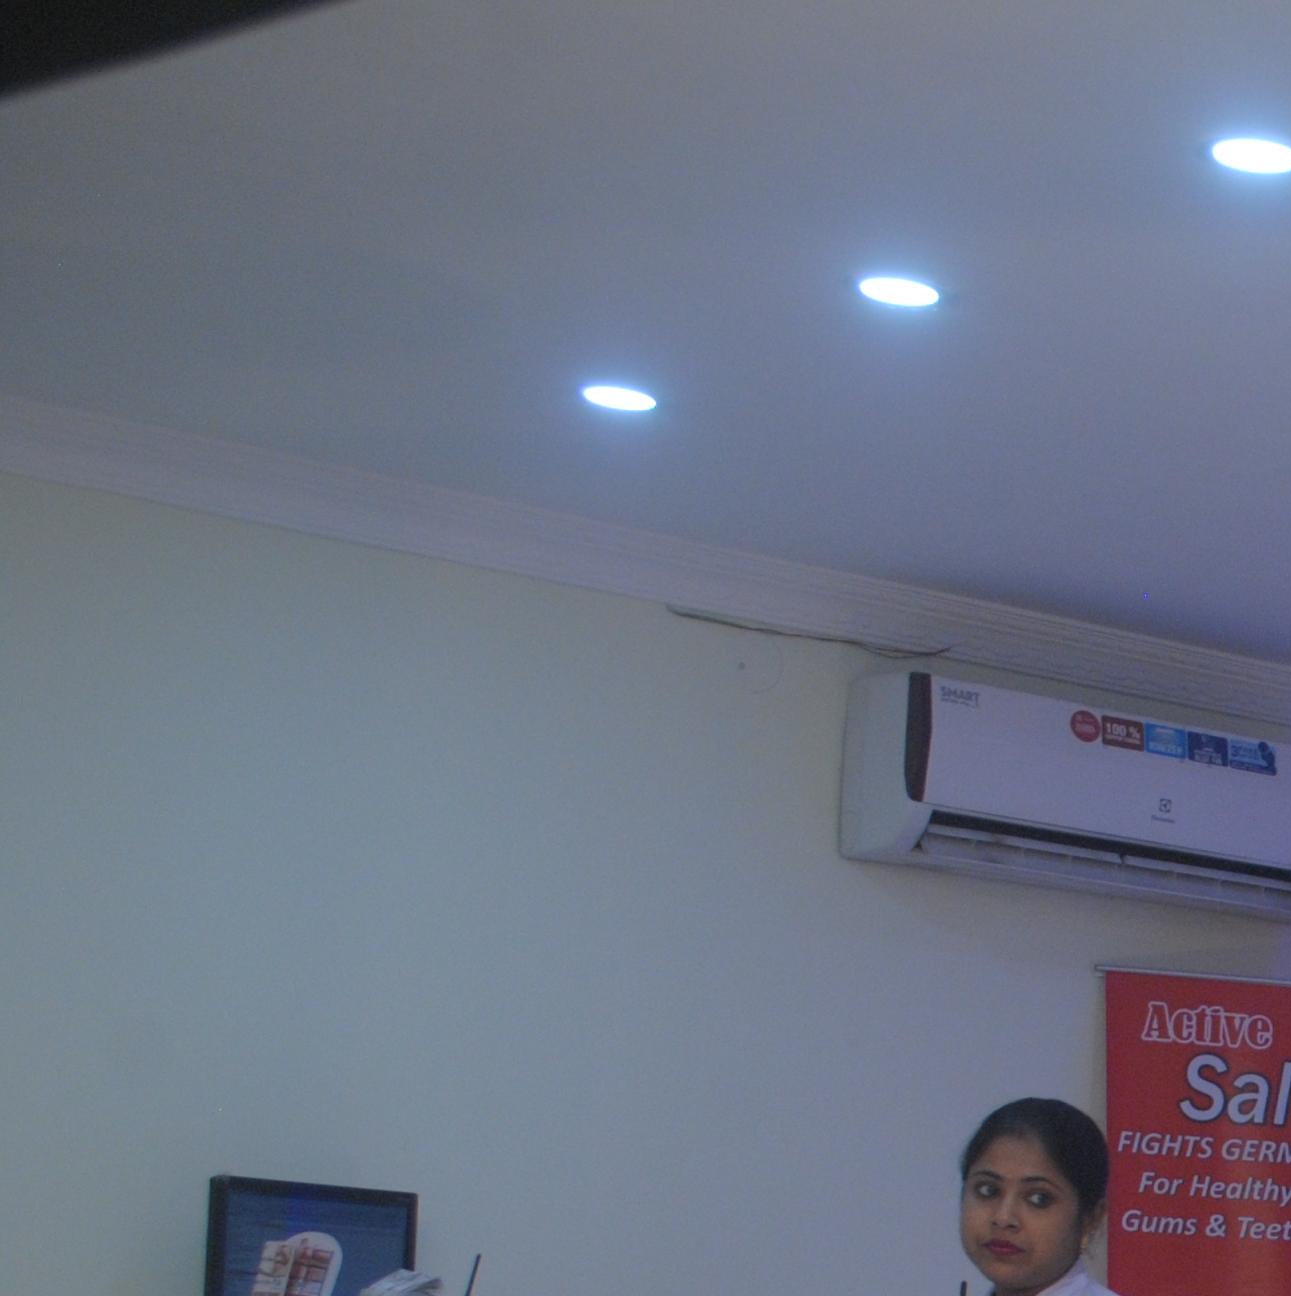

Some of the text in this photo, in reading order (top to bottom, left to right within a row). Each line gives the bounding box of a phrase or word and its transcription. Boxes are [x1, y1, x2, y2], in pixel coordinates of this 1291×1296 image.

[1141, 1001, 1273, 1050] Active
[1118, 1131, 1213, 1159] FIGHTS
[1139, 1172, 1182, 1195] For
[1121, 1210, 1197, 1235] Gums
[1205, 1214, 1226, 1237] &
